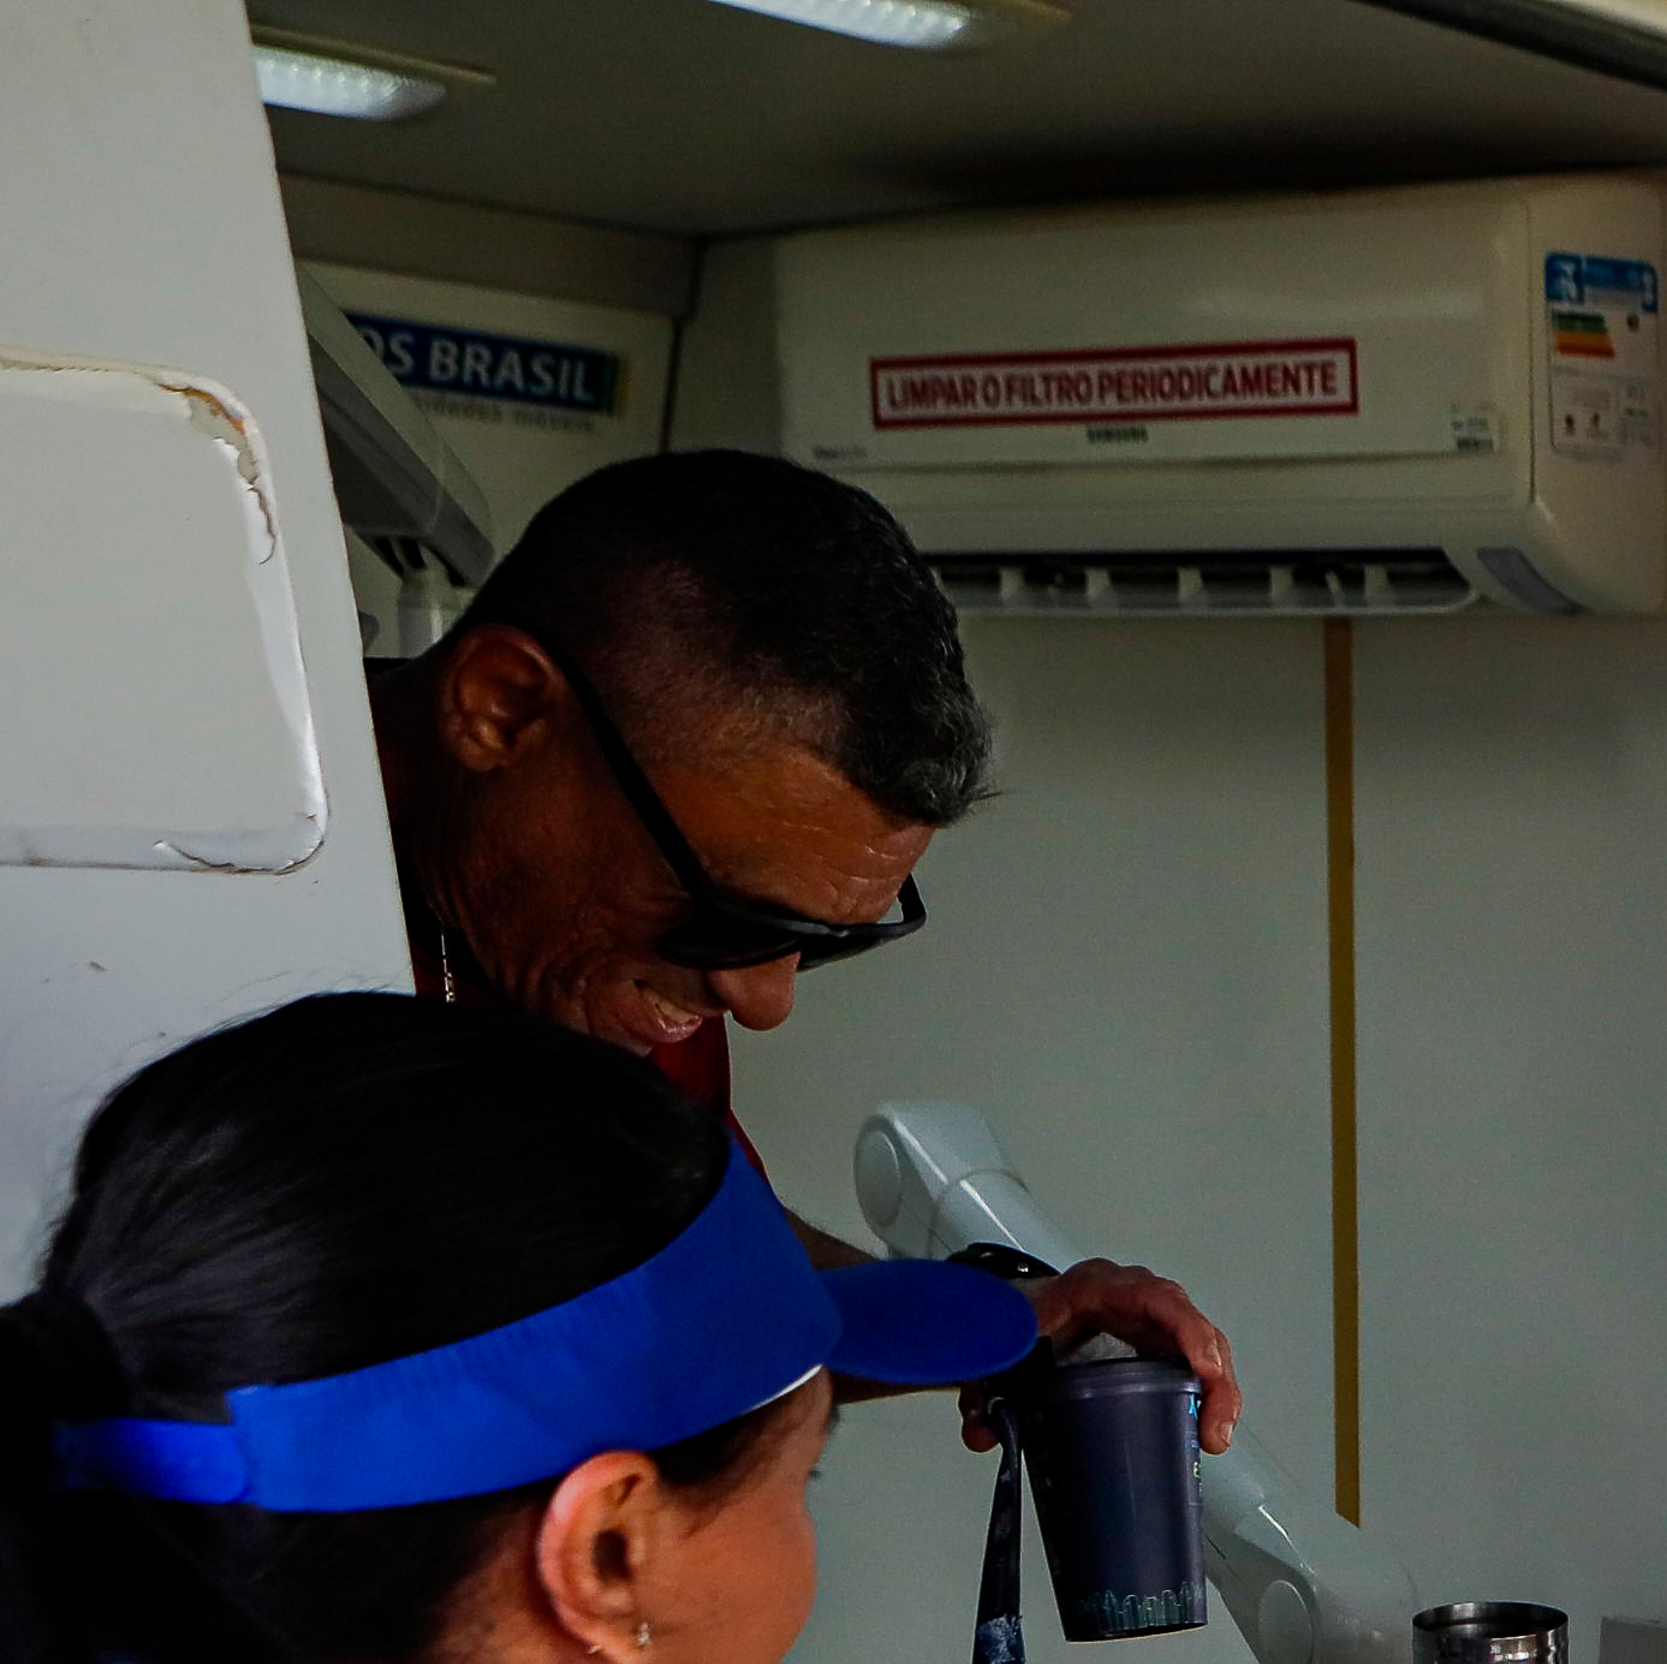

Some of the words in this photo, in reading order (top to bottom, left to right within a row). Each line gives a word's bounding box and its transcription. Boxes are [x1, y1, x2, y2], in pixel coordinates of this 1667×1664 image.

[430, 335, 595, 405] BRASIL
[886, 371, 978, 409] LIMPAR
[983, 373, 1002, 409] O
[1005, 369, 1092, 407] FILTRO
[1098, 361, 1336, 407] PERIODICAMENTE
